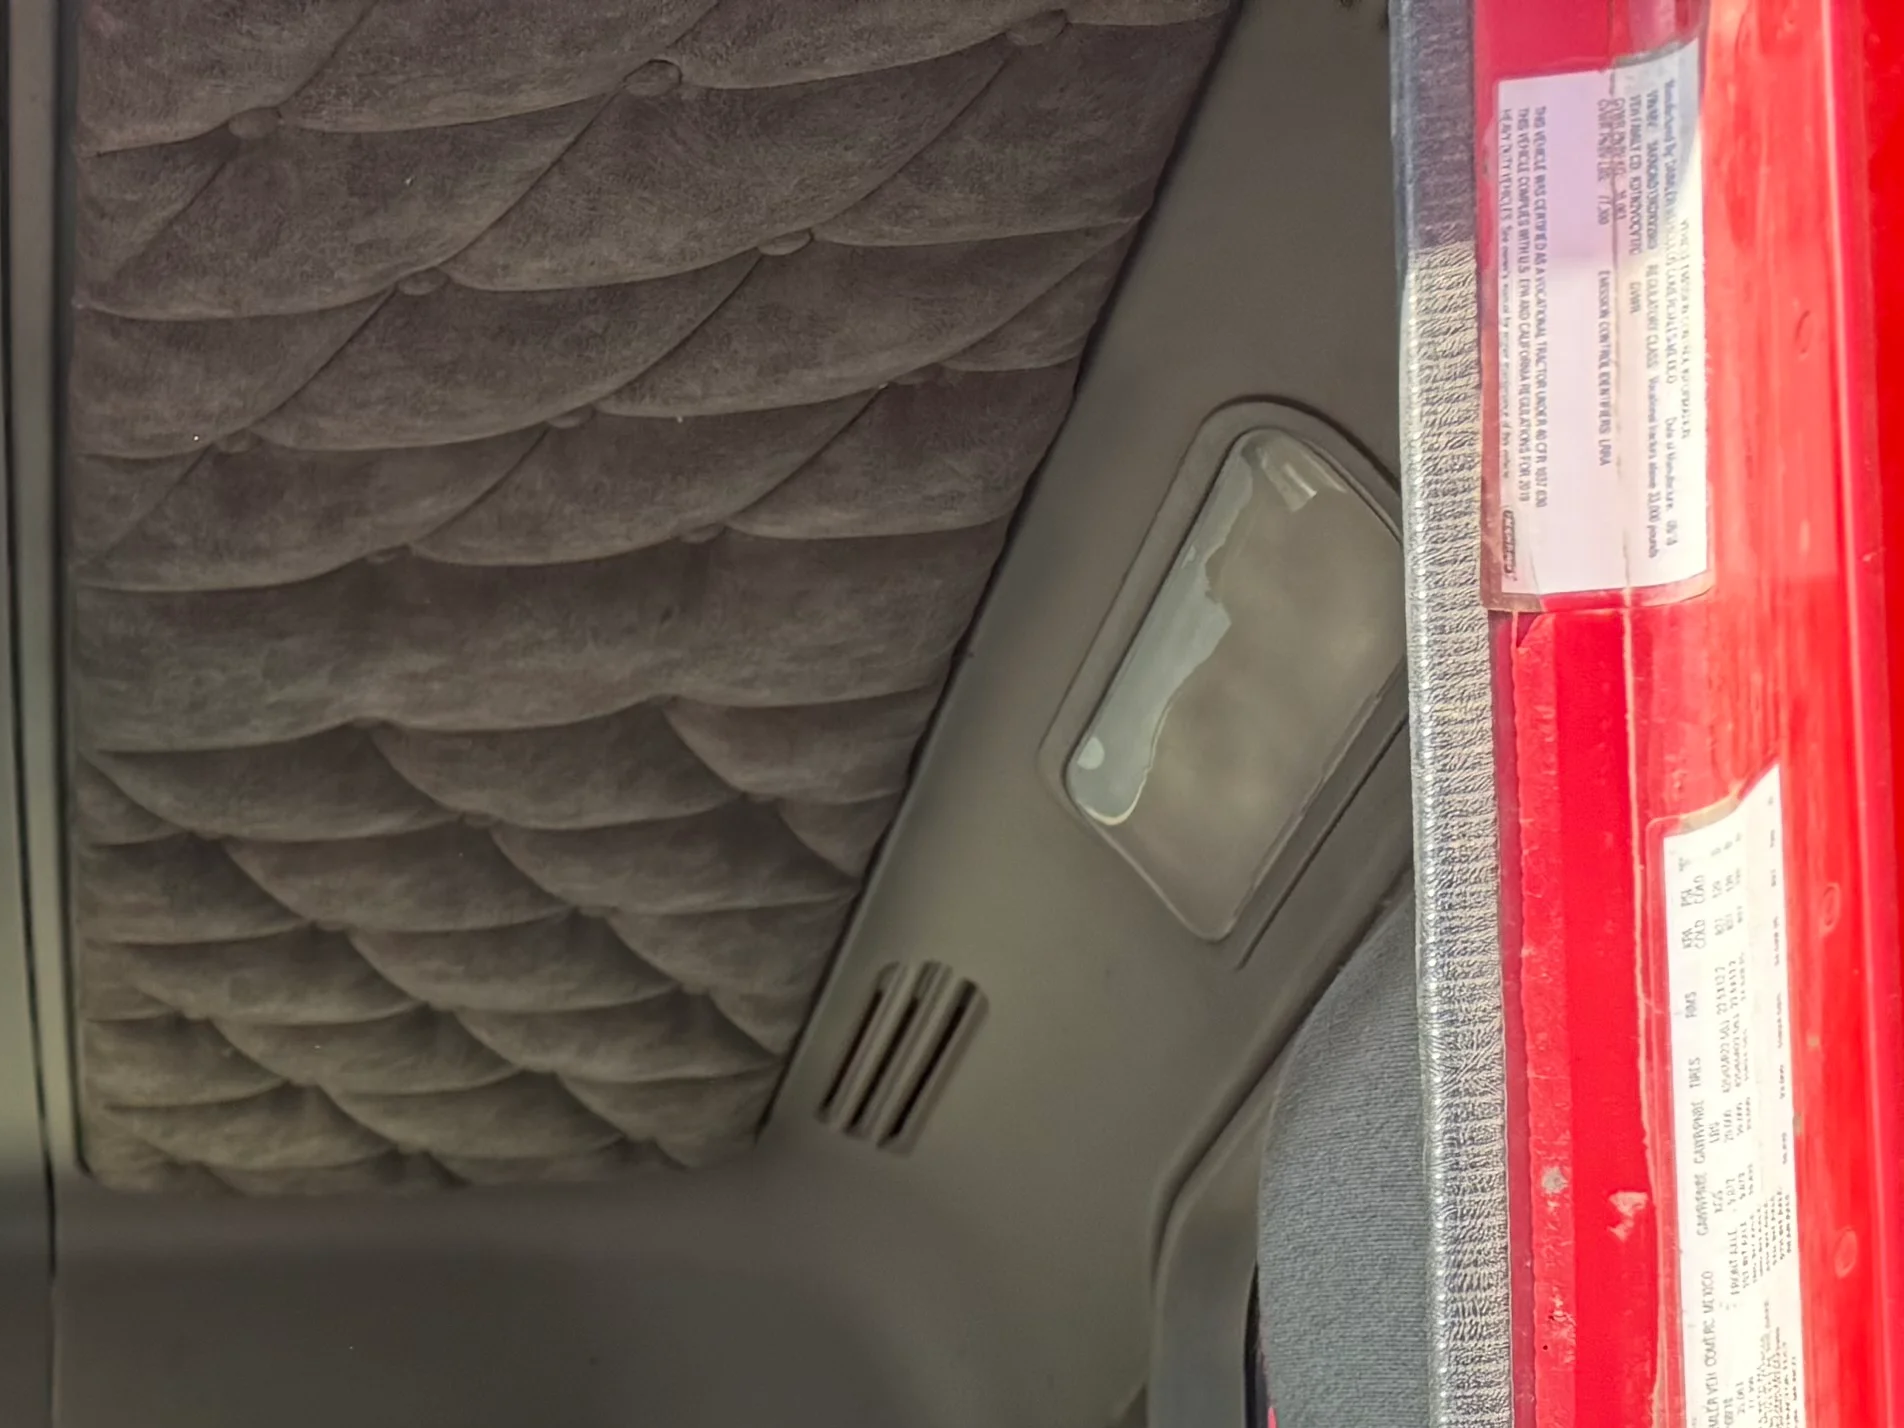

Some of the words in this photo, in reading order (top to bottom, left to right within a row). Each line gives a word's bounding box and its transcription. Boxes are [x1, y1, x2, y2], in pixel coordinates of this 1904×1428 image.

[1518, 133, 1531, 173] VEHICLE
[1534, 131, 1547, 172] VEHICLE
[1518, 175, 1531, 227] COMPLIES
[1534, 174, 1547, 197] WAS
[1518, 299, 1531, 321] AND
[1518, 323, 1531, 382] CALIFORNIA
[1534, 341, 1547, 388] TRACTOR
[1518, 384, 1531, 454] REGULATIONS
[1534, 390, 1547, 427] UNDER
[1518, 456, 1531, 477] FOR
